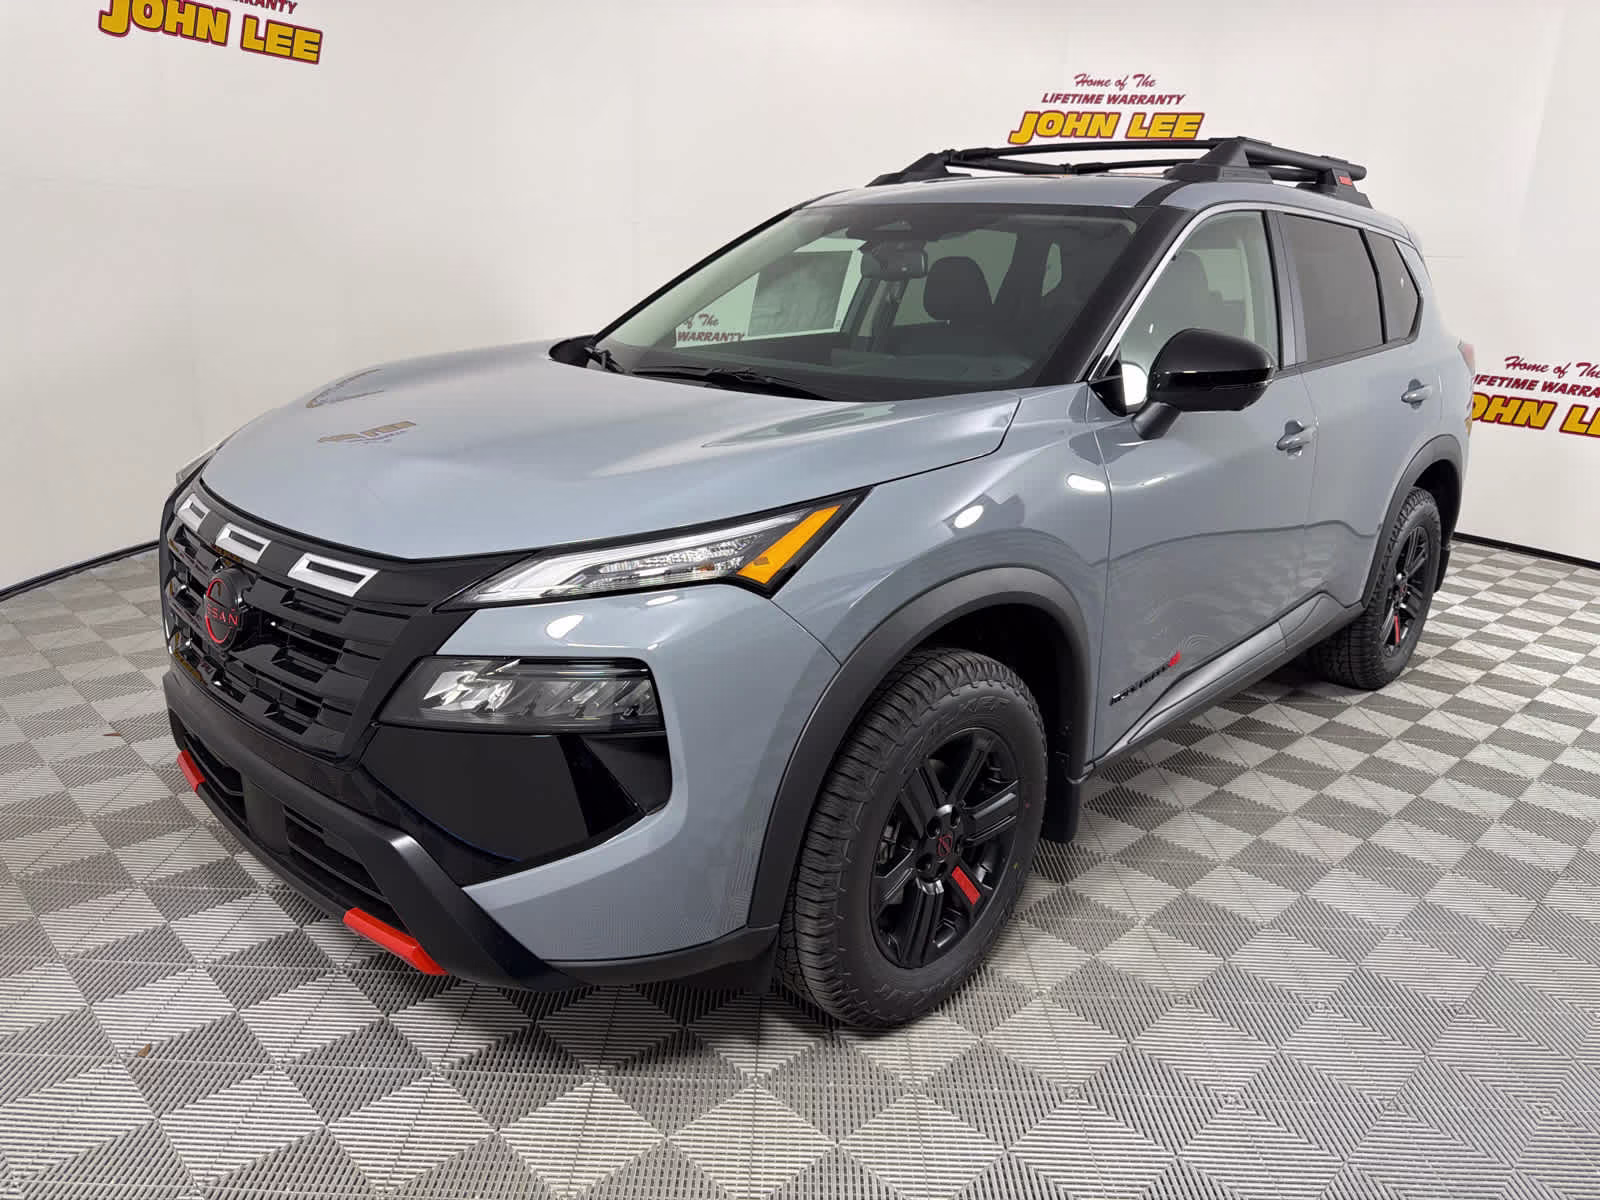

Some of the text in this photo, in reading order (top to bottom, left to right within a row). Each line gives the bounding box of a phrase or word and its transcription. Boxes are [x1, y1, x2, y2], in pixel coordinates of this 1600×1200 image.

[98, 0, 323, 65] JOHN LEE
[1074, 73, 1157, 91] Home of The
[1041, 93, 1186, 105] LIFETIME WARRANTY
[1008, 109, 1204, 145] JOHN LEE
[677, 331, 745, 345] WARRANTY
[1504, 355, 1550, 373] Home
[1553, 362, 1571, 379] of
[1473, 374, 1540, 391] IFETIME
[1472, 391, 1558, 430] OHN
